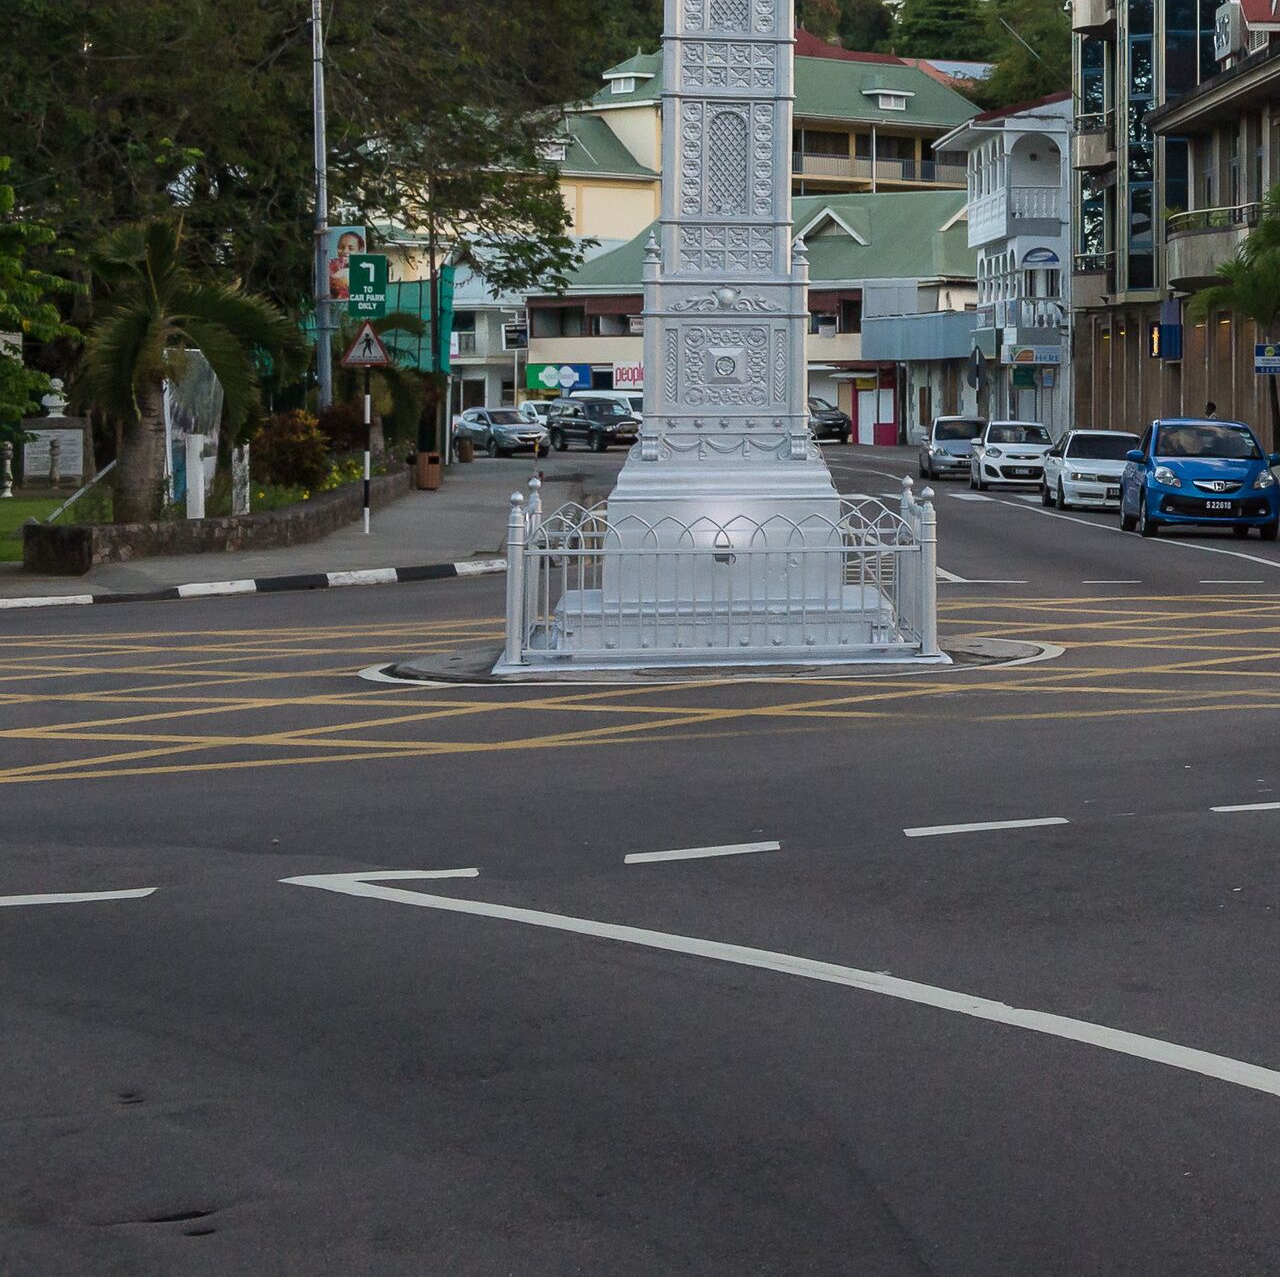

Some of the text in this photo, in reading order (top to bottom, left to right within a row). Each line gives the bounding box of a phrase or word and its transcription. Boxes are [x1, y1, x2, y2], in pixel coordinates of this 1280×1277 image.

[350, 294, 385, 302] CAR PARK
[358, 302, 377, 310] ONLY
